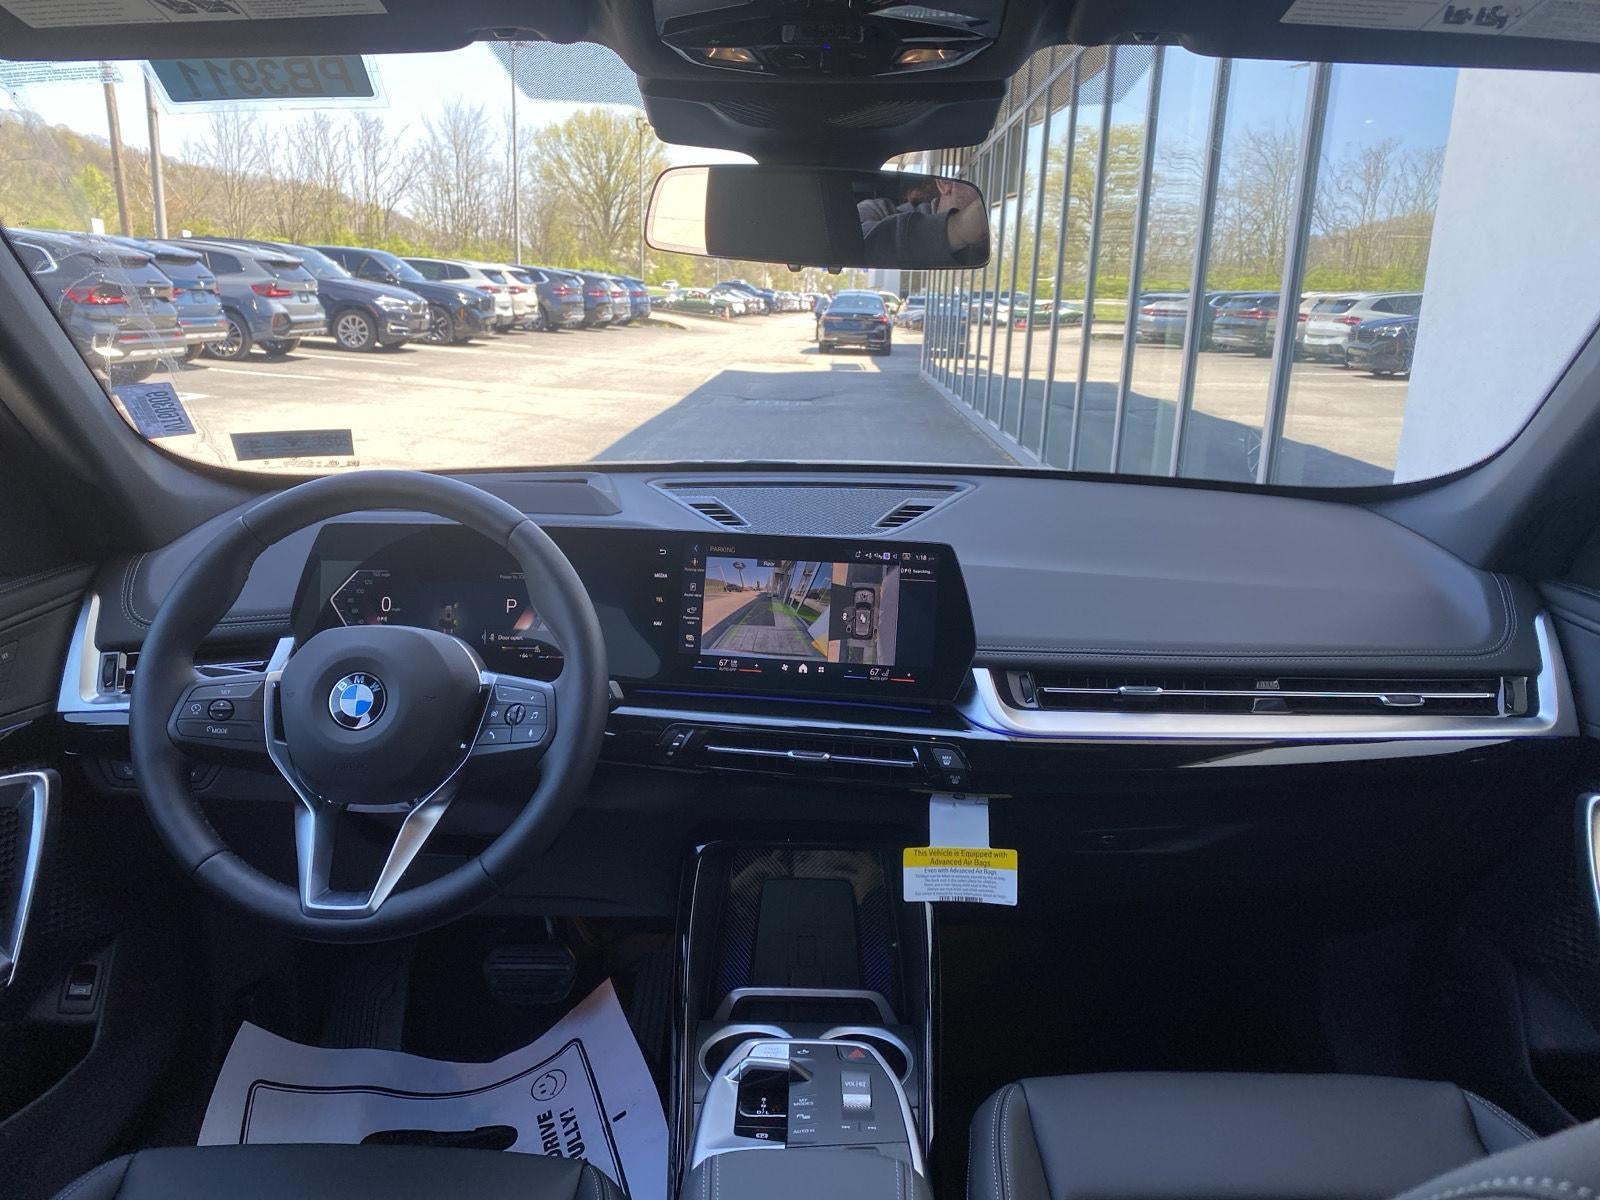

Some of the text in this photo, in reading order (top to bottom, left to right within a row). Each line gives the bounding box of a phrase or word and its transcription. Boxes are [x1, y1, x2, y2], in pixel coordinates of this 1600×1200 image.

[709, 545, 736, 553] PARKING
[381, 596, 392, 612] 0
[506, 598, 518, 614] P
[337, 675, 381, 693] BMW
[914, 849, 928, 857] This
[929, 849, 953, 857] Vehicle
[961, 850, 993, 859] Equipped
[993, 851, 1008, 859] with
[930, 858, 962, 866] Advanced
[974, 859, 991, 867] Bags
[559, 1106, 588, 1161] ULLY!
